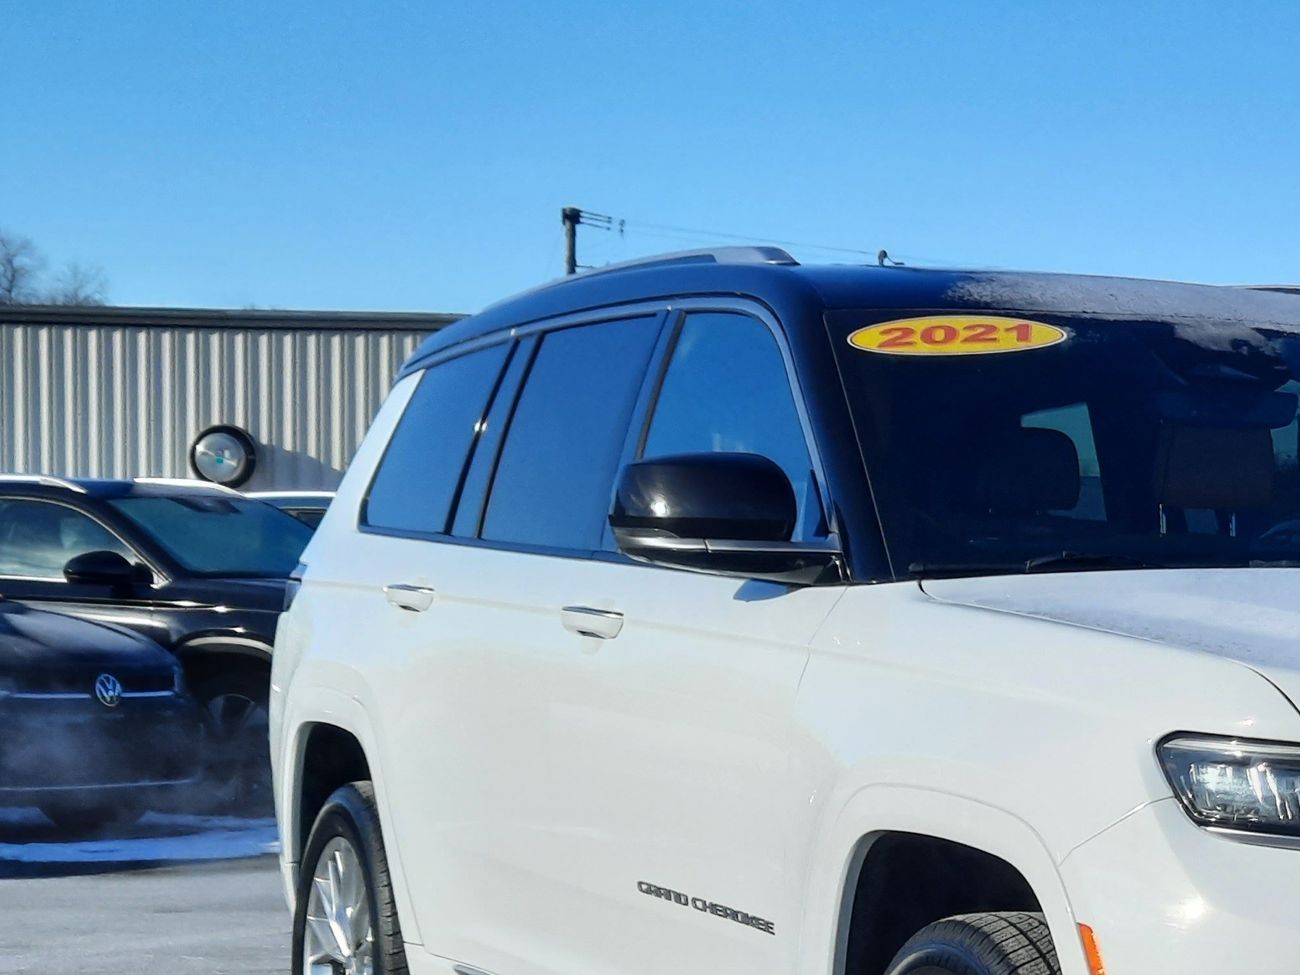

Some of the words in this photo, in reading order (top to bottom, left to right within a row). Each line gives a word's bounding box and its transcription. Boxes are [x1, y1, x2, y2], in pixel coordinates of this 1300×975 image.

[877, 323, 1034, 349] 2021
[637, 880, 689, 906] GRAND
[691, 896, 776, 936] CHEROKEE
